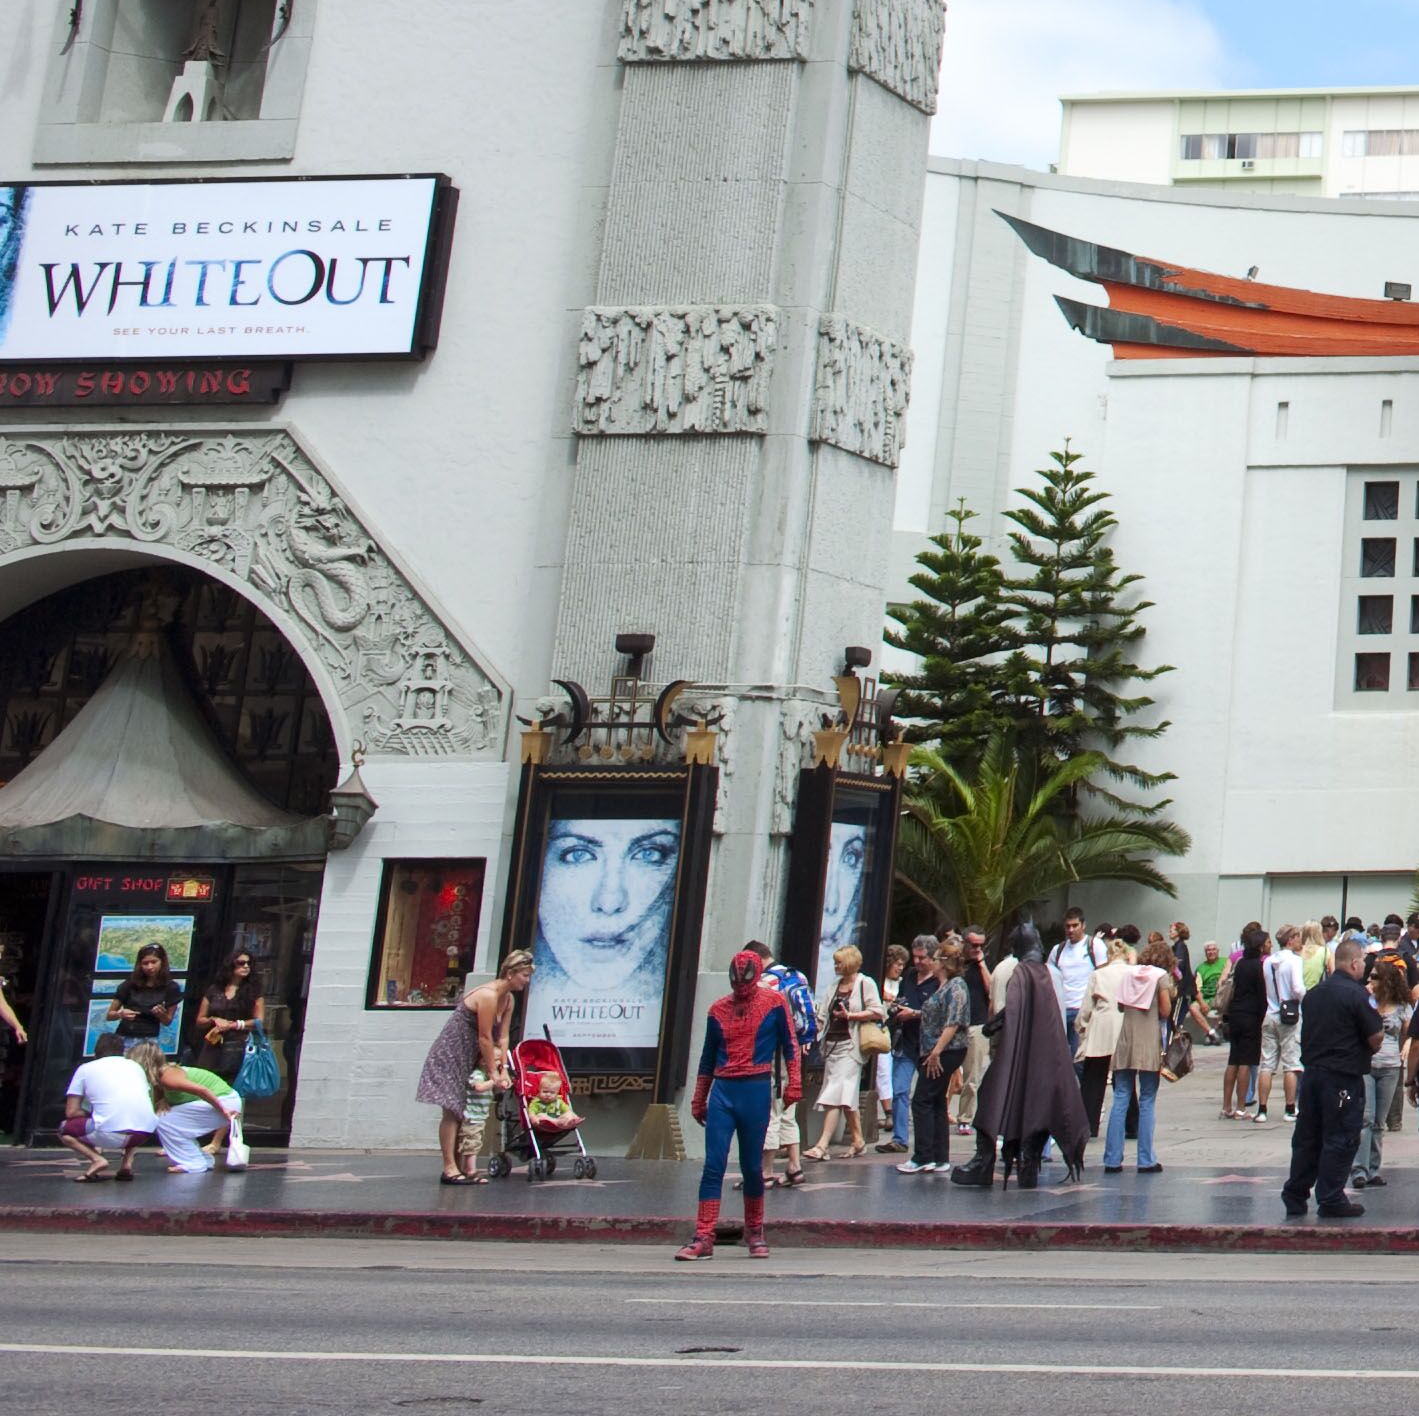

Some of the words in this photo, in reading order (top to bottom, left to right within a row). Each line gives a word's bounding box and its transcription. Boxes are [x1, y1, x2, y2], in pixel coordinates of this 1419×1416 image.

[65, 223, 149, 237] KATE
[172, 219, 394, 235] BECKINSALE
[38, 249, 410, 319] WHITEOUT
[113, 327, 141, 336] SEE
[148, 326, 190, 336] YOUR
[197, 326, 236, 335] LAST
[0, 370, 61, 398] OW
[74, 368, 251, 398] SHOWING
[552, 1003, 645, 1021] WHITEOUT
